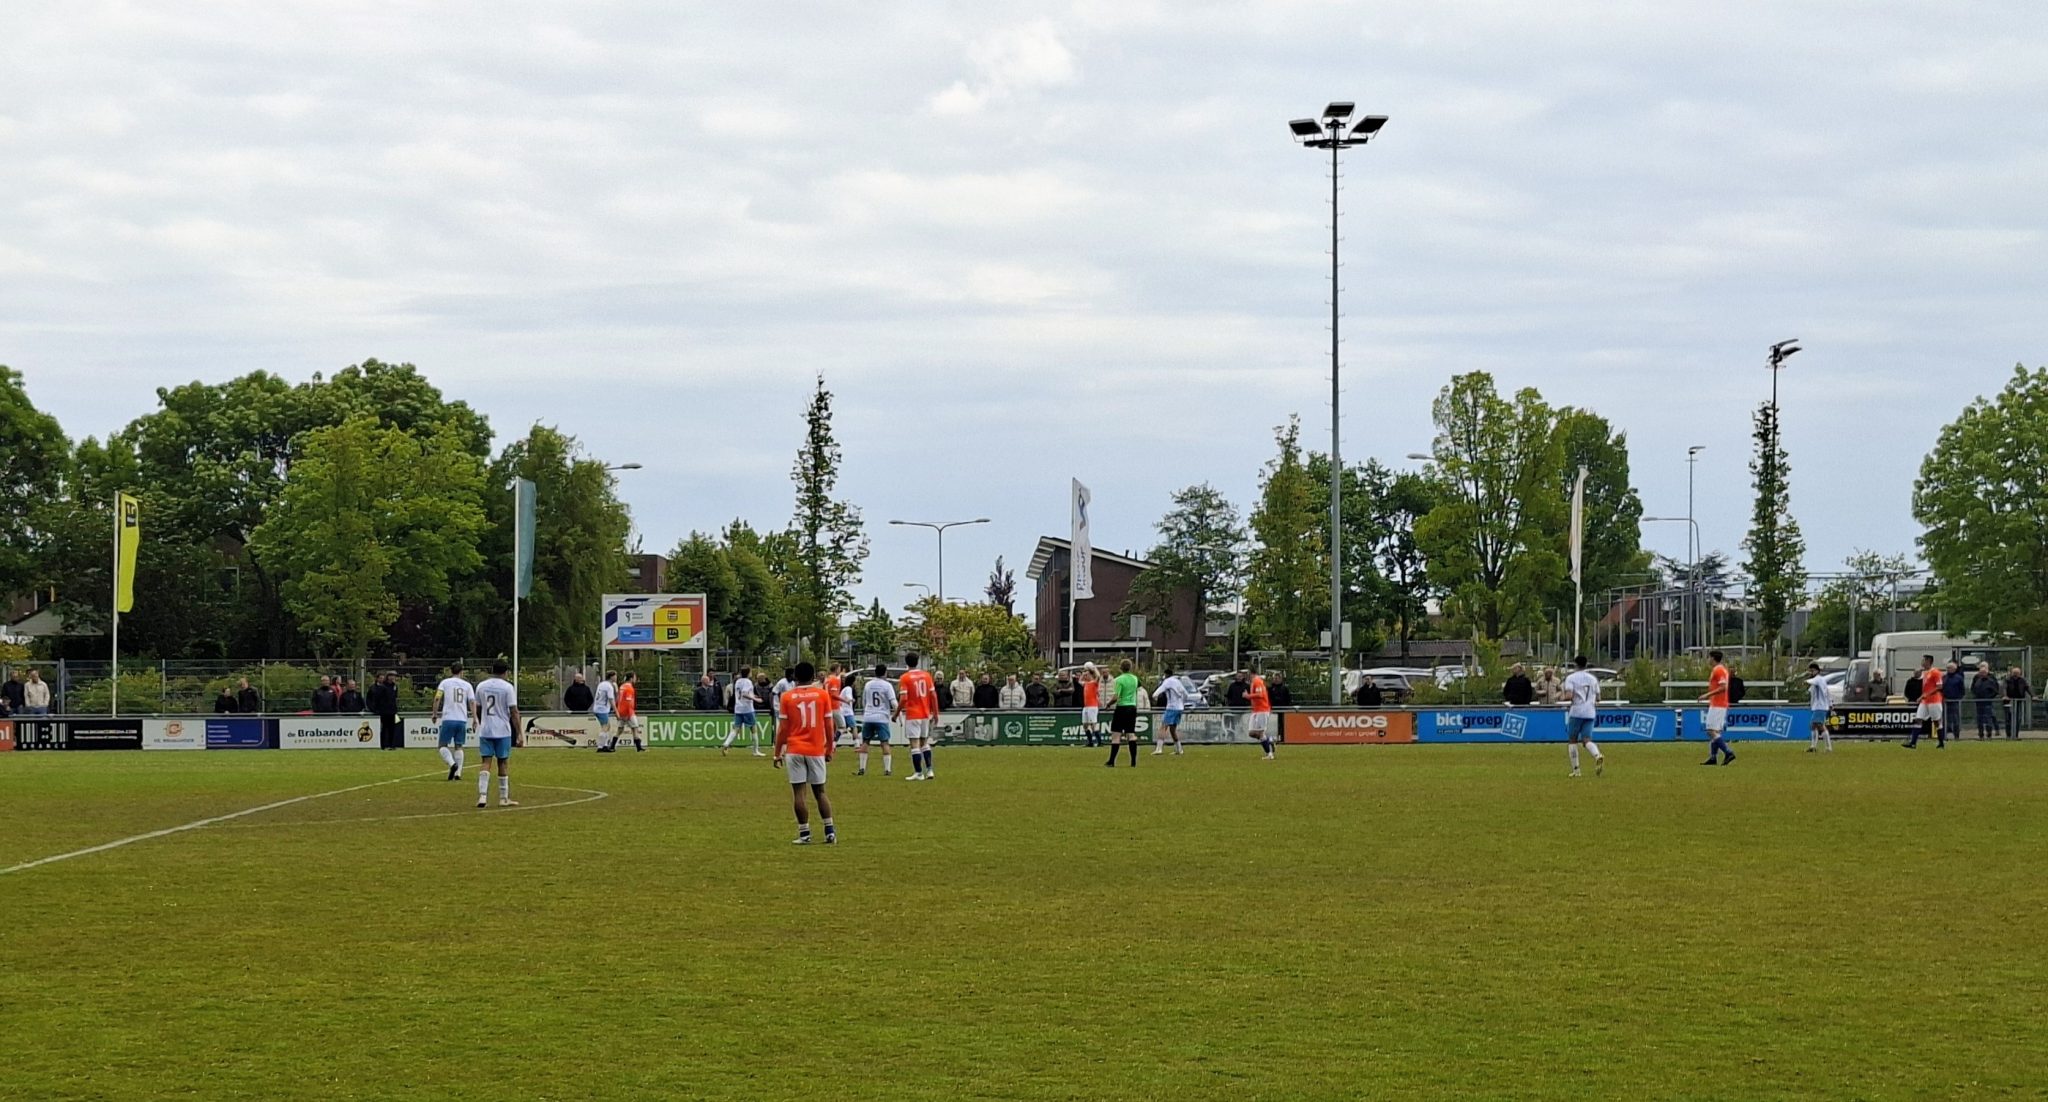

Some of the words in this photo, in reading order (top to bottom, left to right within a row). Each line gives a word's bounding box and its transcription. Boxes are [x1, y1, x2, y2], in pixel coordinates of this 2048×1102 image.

[913, 679, 927, 697] 10
[486, 694, 496, 716] 2
[872, 691, 880, 707] 6
[796, 700, 816, 728] 11
[1308, 716, 1388, 729] VAMOS
[297, 728, 353, 738] Brabander
[649, 721, 677, 742] EW
